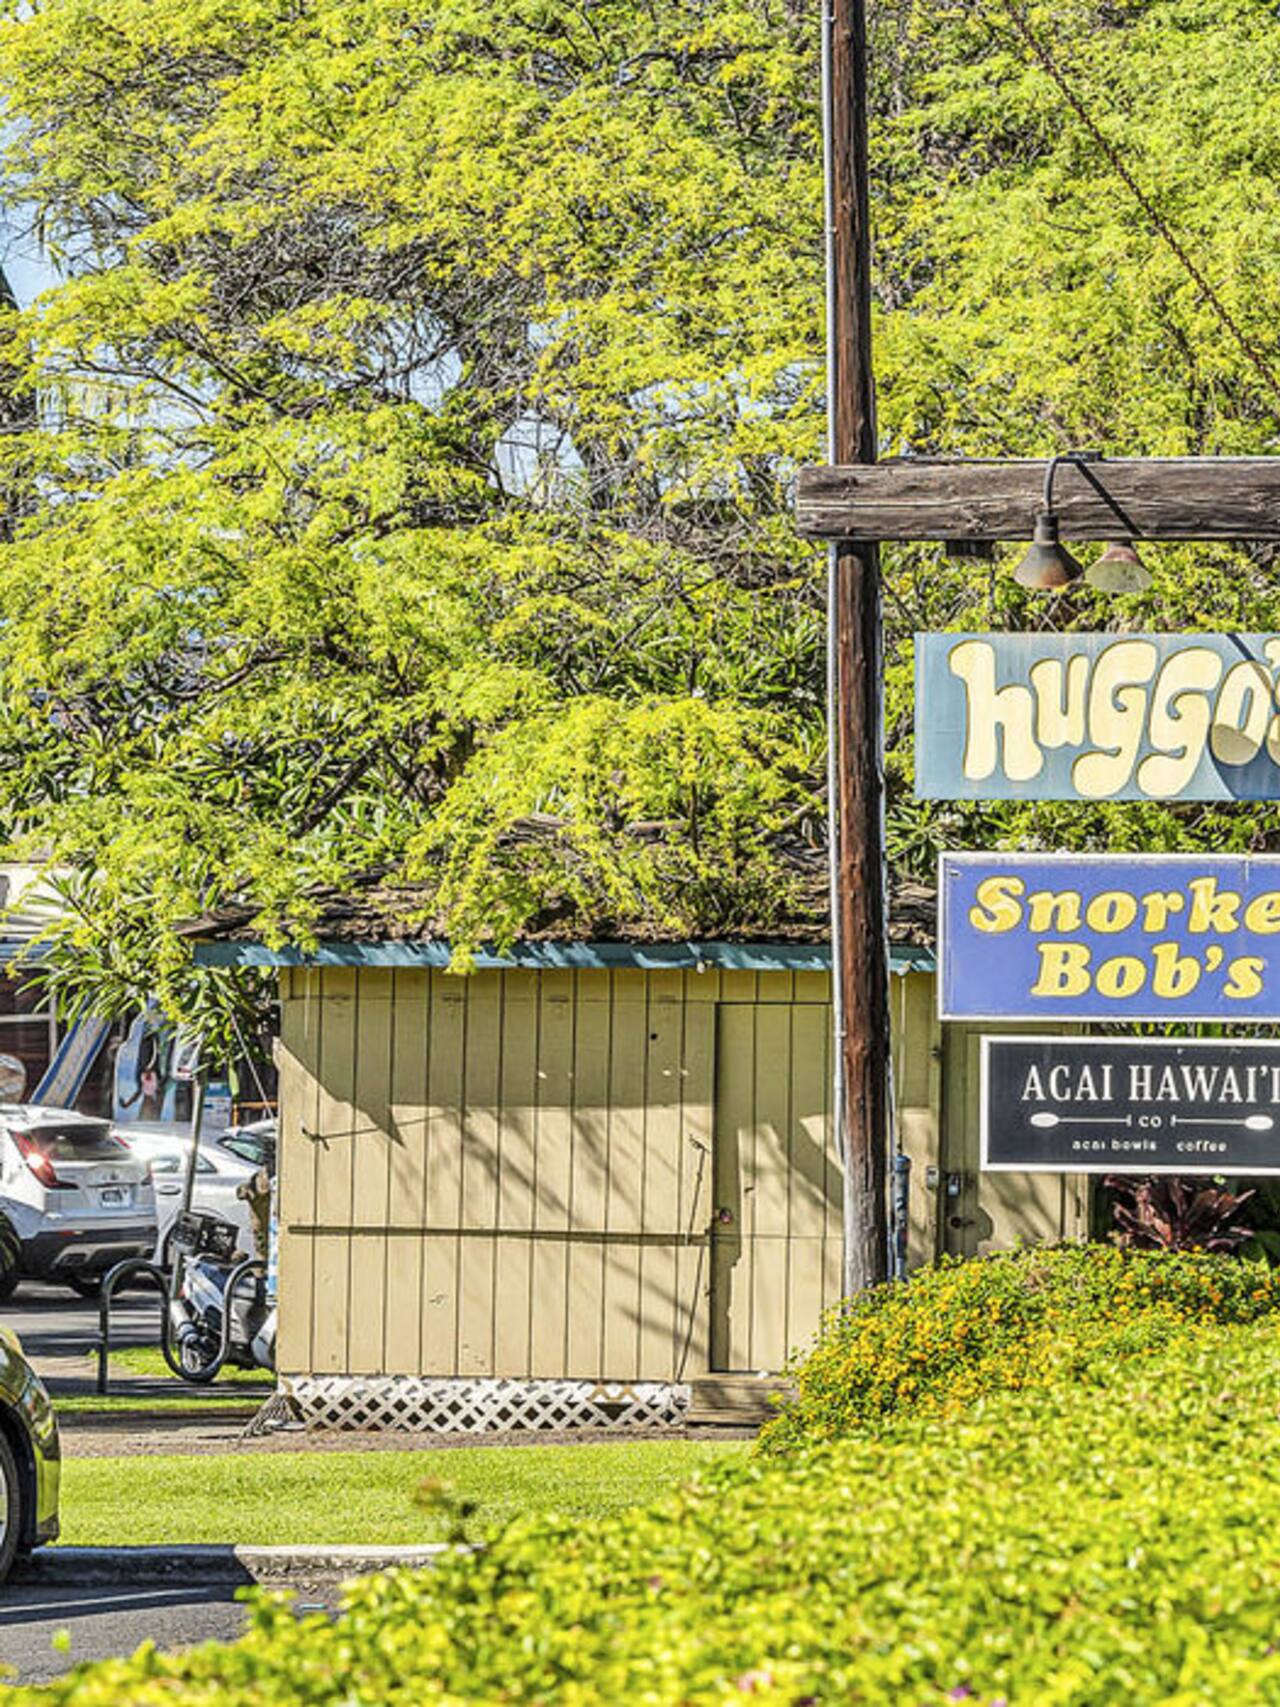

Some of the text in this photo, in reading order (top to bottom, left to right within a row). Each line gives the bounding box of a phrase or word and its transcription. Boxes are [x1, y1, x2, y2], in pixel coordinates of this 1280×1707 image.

[1030, 942, 1266, 999] Bob's
[1021, 1064, 1113, 1102] ACAI
[1111, 1139, 1157, 1151] bowls
[1176, 1140, 1227, 1152] coffee
